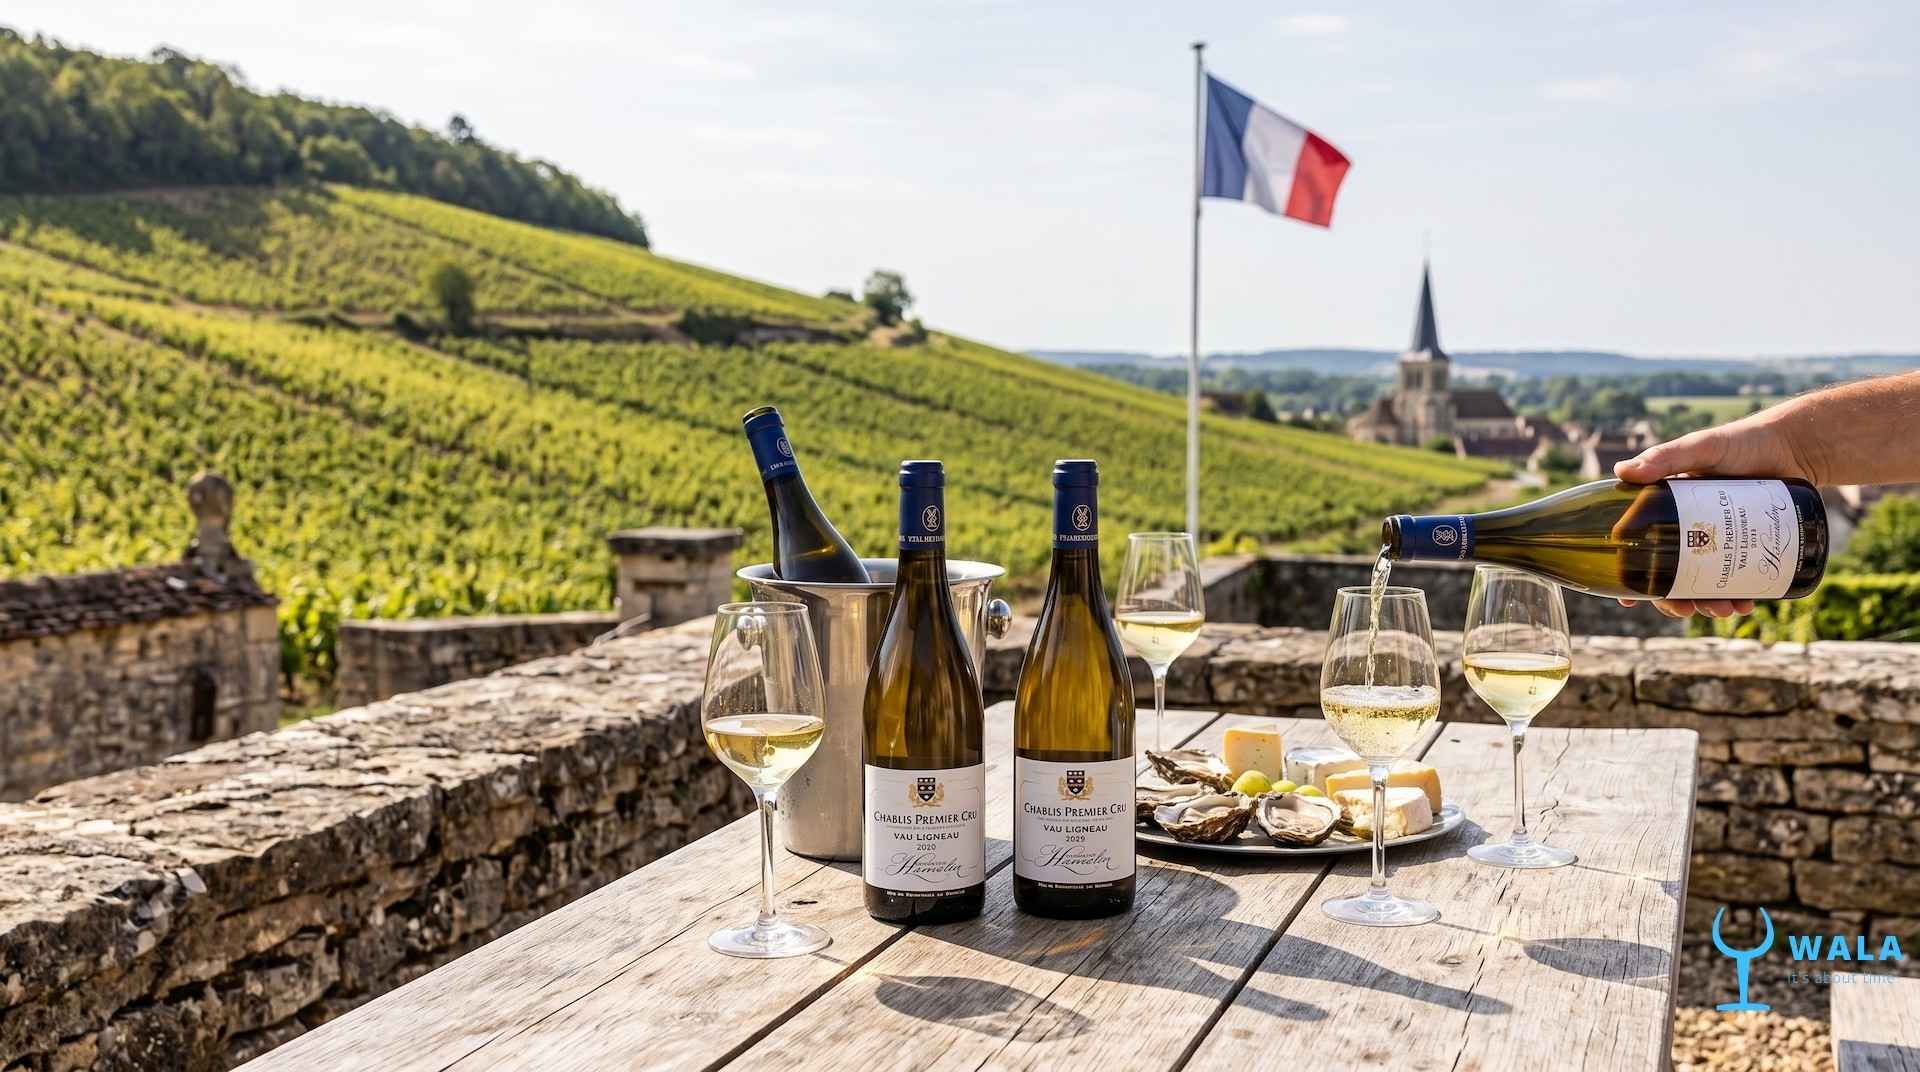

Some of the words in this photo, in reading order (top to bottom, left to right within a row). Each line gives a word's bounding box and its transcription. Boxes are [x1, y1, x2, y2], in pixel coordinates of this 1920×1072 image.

[1024, 802, 1062, 817] CHABLIS
[1065, 807, 1108, 818] PREMIER
[1110, 803, 1127, 814] CRU
[873, 810, 912, 825] CHABLIS
[915, 814, 959, 825] PREMIER
[961, 810, 977, 821] CRU
[1043, 824, 1062, 833] VAU
[1065, 824, 1108, 833] LIGNEAU
[894, 833, 913, 841] VAU
[916, 832, 960, 841] LIGNEAU
